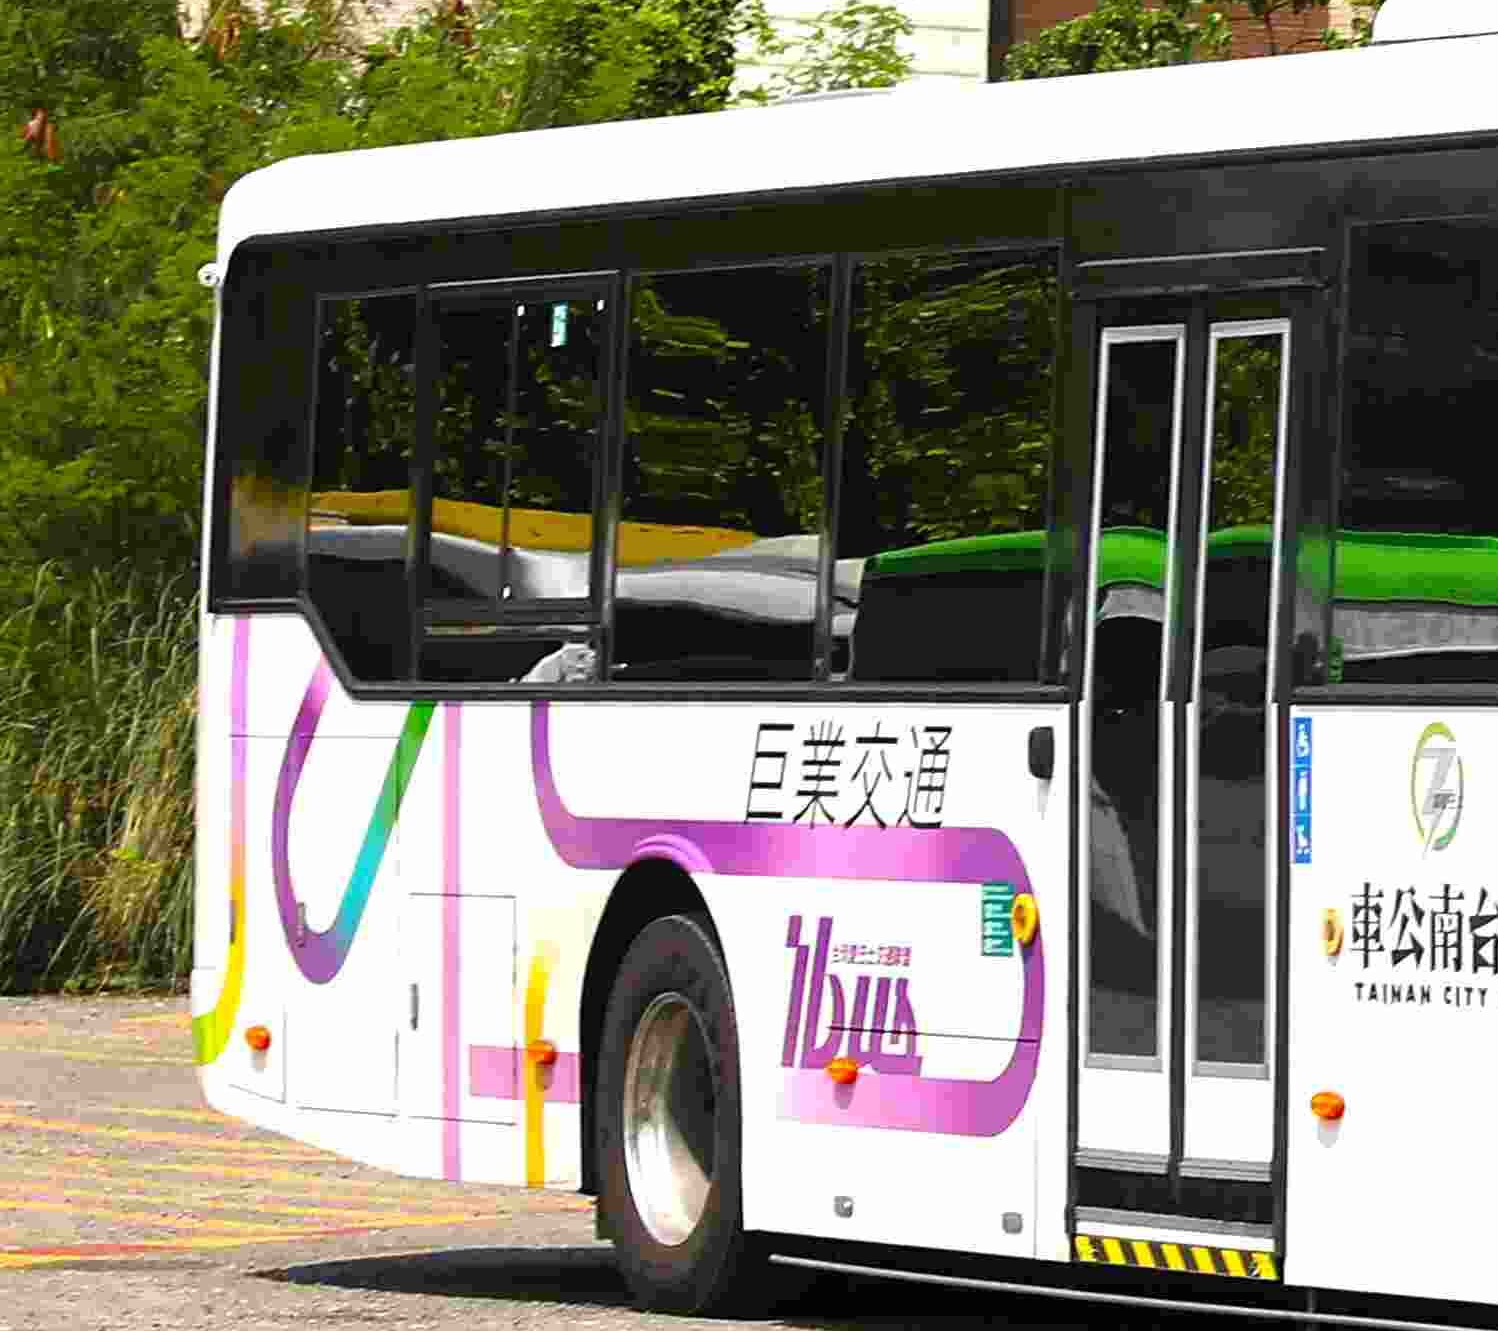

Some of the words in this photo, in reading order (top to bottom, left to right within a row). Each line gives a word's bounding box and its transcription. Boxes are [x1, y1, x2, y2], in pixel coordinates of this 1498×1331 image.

[744, 720, 953, 830] 巨業交通
[1353, 982, 1432, 1004] TAINAN
[1443, 986, 1488, 1008] CITY
